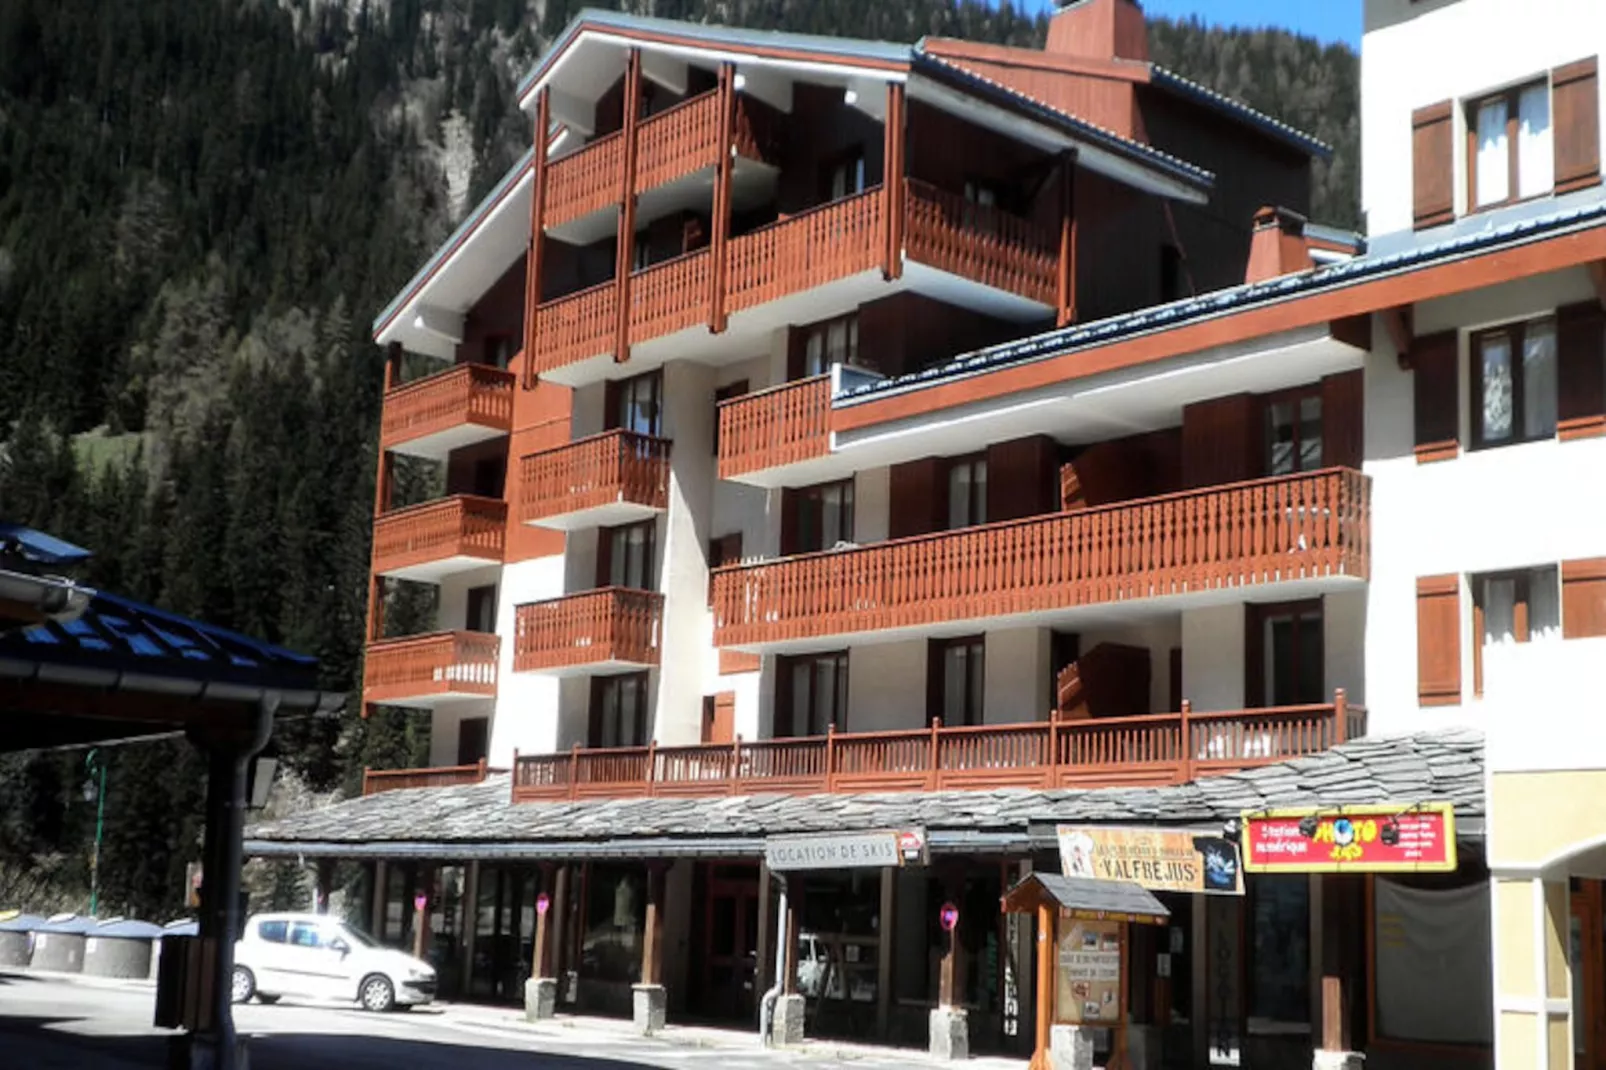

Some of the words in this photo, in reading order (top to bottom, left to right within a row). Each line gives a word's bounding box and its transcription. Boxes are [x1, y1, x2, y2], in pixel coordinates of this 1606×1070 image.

[771, 846, 836, 863] LOCATION
[840, 844, 857, 859] DE
[863, 842, 894, 857] SKIS
[1101, 858, 1196, 883] VALFREJUS
